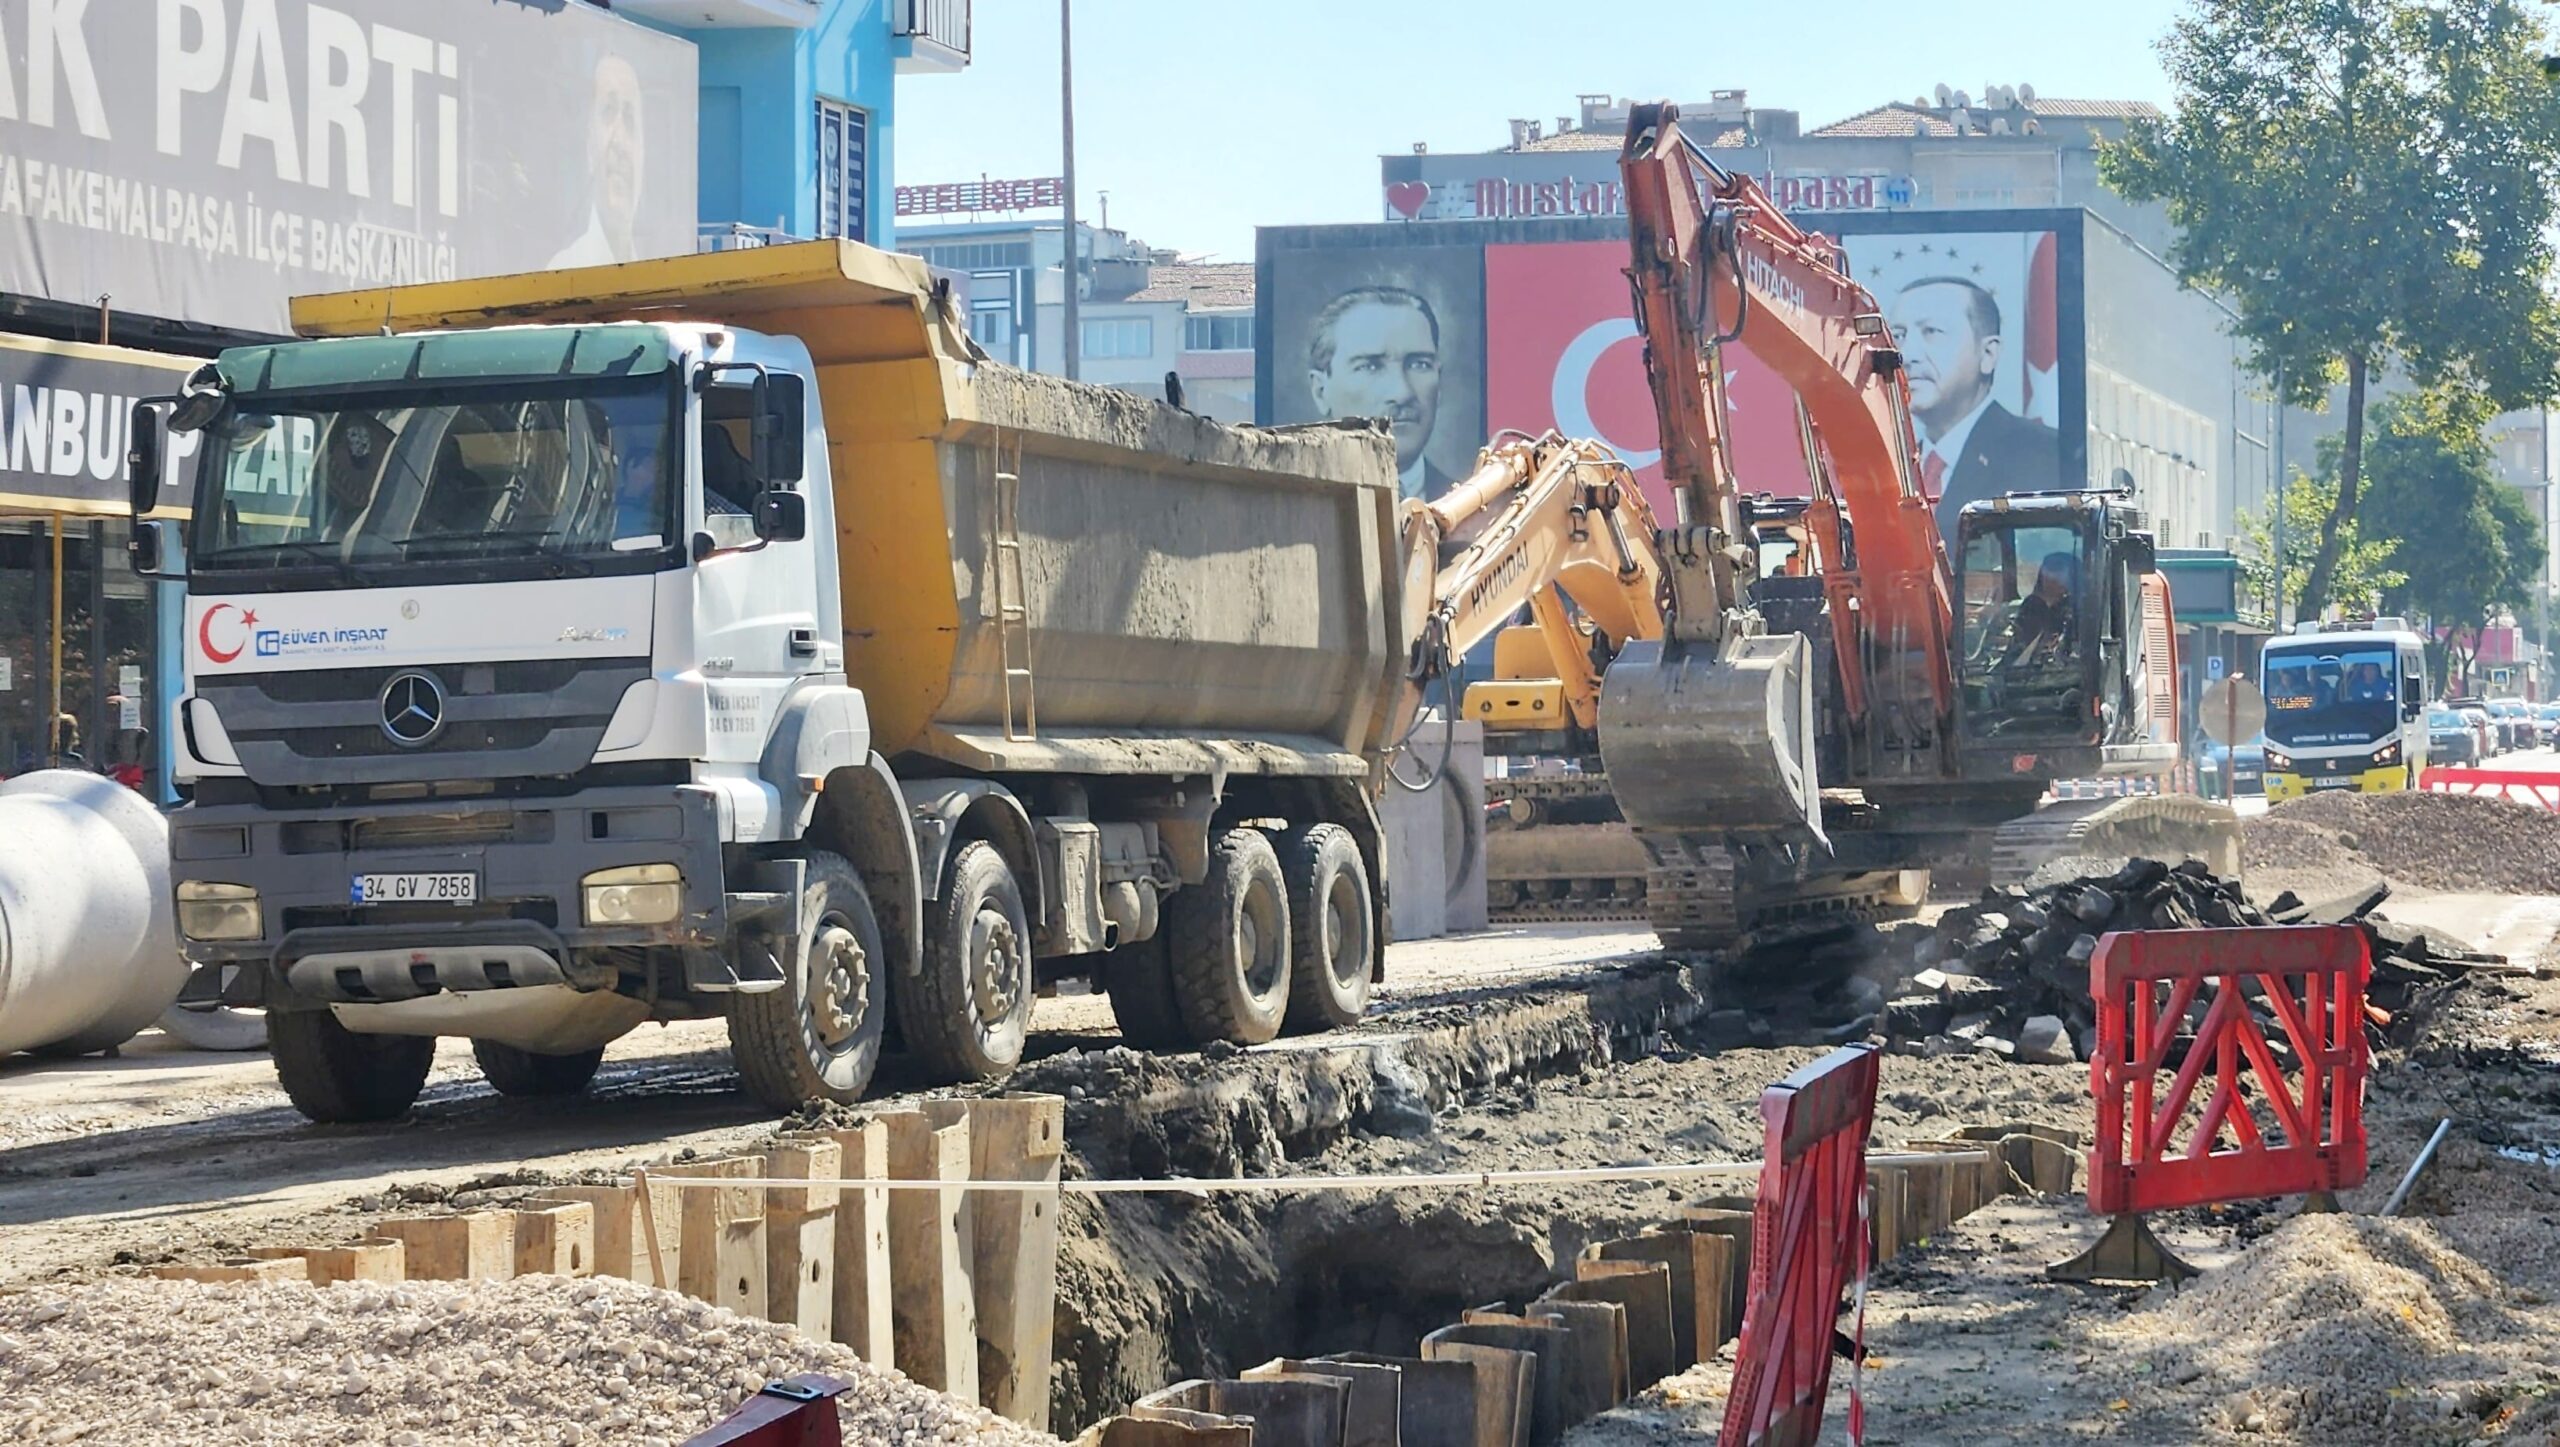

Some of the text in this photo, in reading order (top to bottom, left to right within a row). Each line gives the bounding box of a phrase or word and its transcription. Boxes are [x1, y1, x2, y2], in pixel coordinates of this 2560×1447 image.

[157, 0, 458, 218] PARTİ
[0, 153, 456, 288] AFAKEMALPAŞA İLÇE BAŞKANLIĞI
[1747, 251, 1804, 319] HITACHI
[0, 383, 138, 482] NBU
[1471, 540, 1529, 617] HYUNDAI
[365, 876, 470, 898] 34 GV 7858
